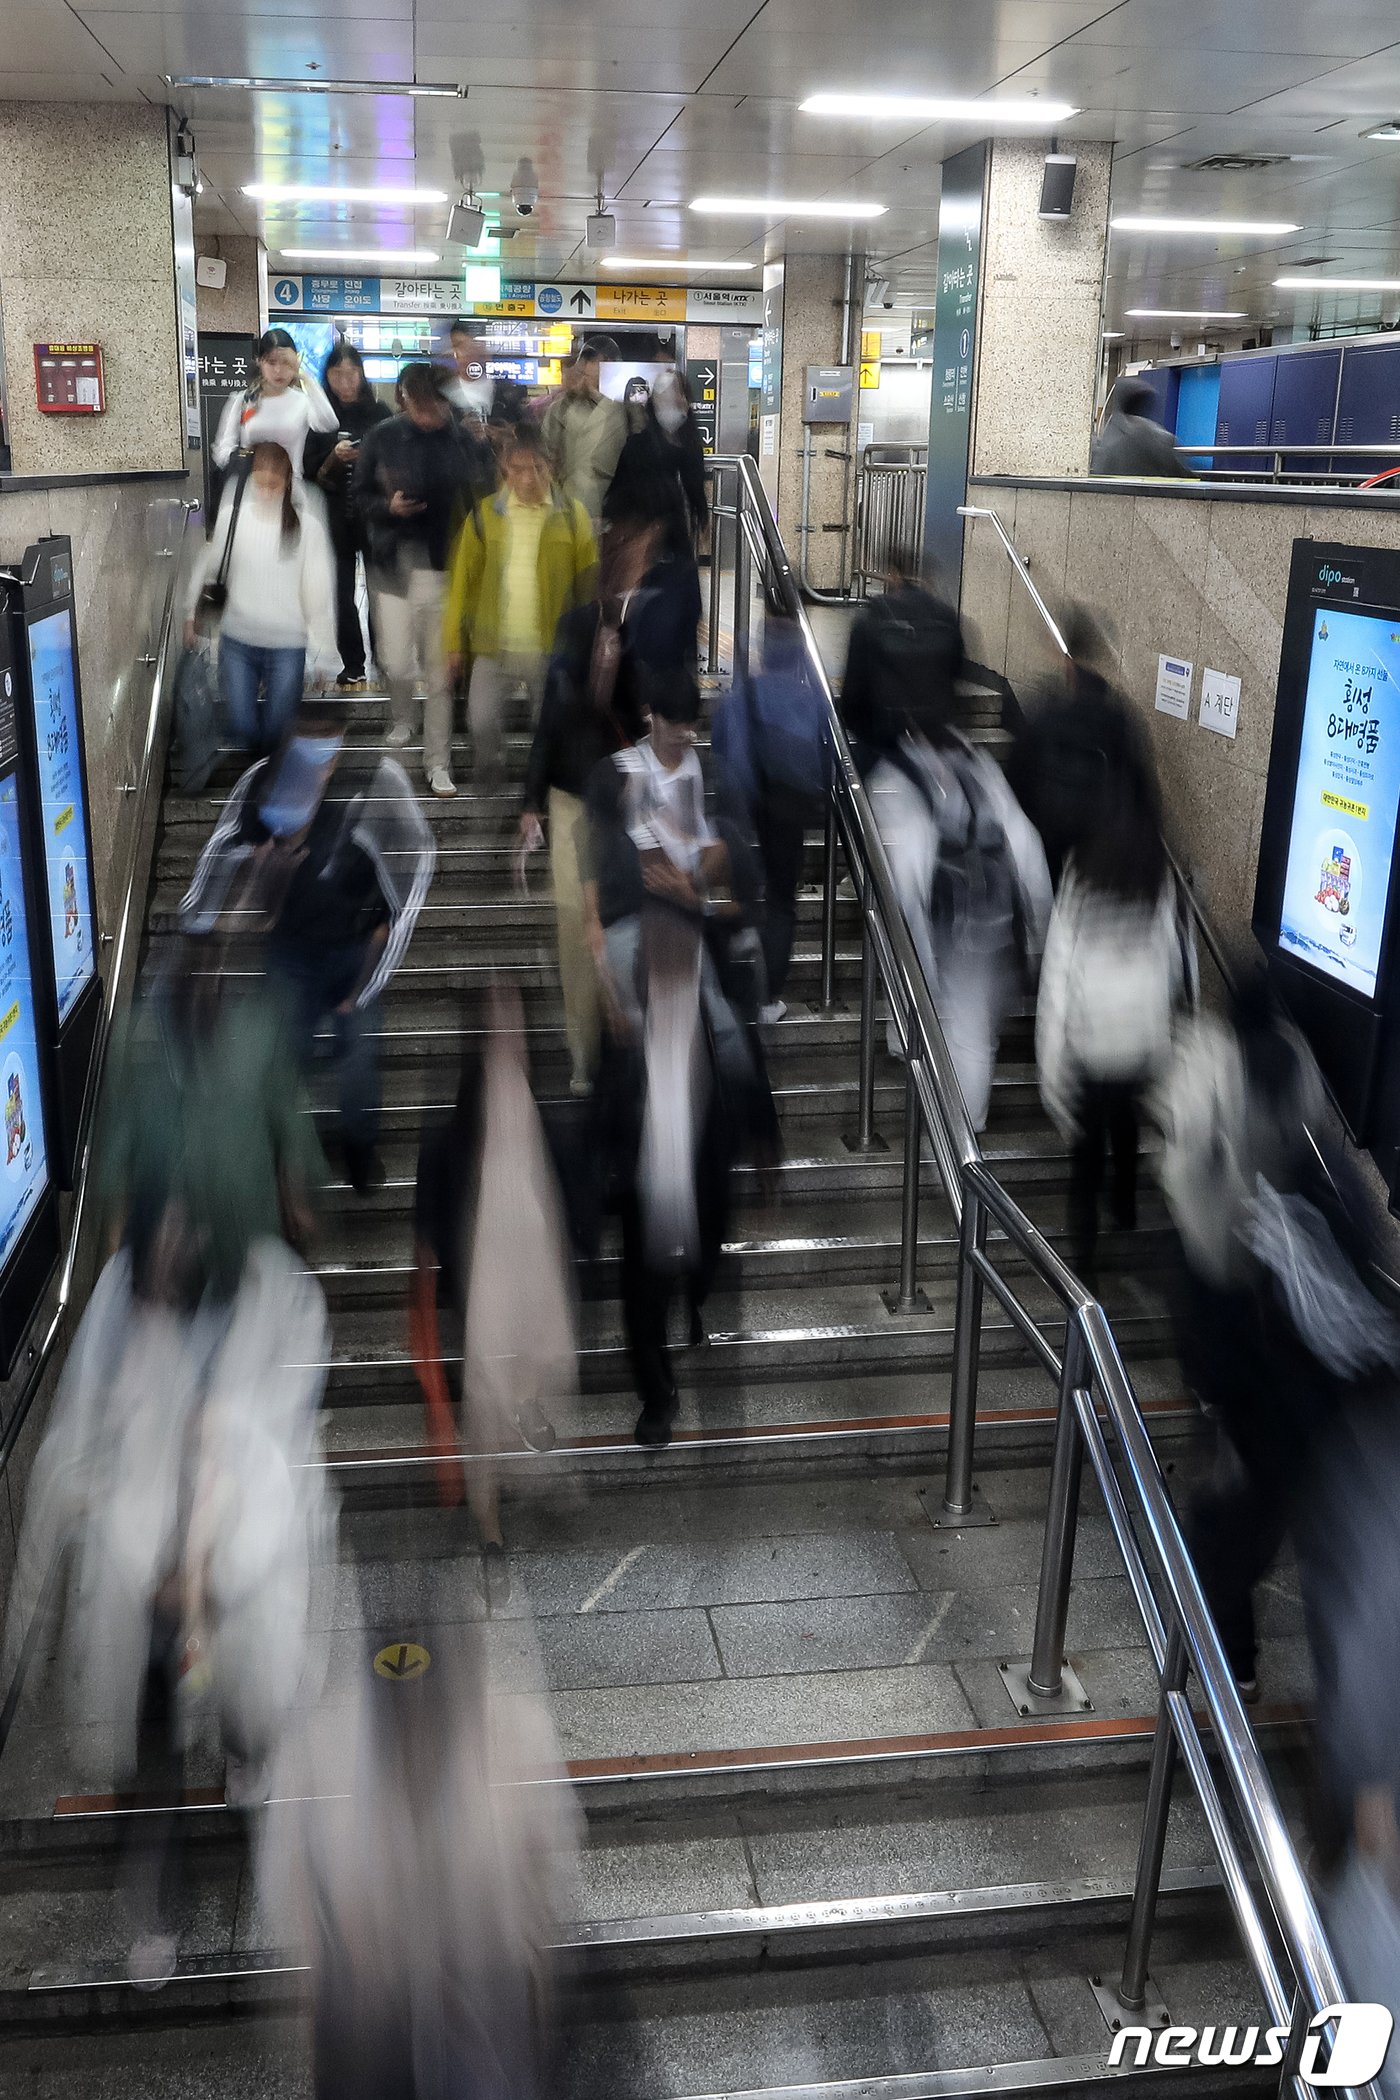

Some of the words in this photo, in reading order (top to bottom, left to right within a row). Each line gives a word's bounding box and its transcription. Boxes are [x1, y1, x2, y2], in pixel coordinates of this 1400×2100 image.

[966, 264, 974, 286] 곳
[311, 294, 331, 304] 사당
[344, 295, 372, 305] 오이도
[394, 282, 445, 298] 갈아타는
[449, 283, 462, 300] 곳
[613, 290, 651, 306] 나가는
[655, 291, 668, 306] 곳
[393, 300, 421, 309] Transfer
[613, 307, 627, 316] Exit
[232, 357, 248, 375] 곳
[1318, 564, 1342, 588] dipo
[1355, 663, 1361, 675] 온
[1361, 665, 1377, 679] 8가지
[1204, 692, 1211, 708] A
[1214, 694, 1234, 717] 계단
[1343, 678, 1373, 714] 횡성
[1327, 713, 1380, 754] 8대명품
